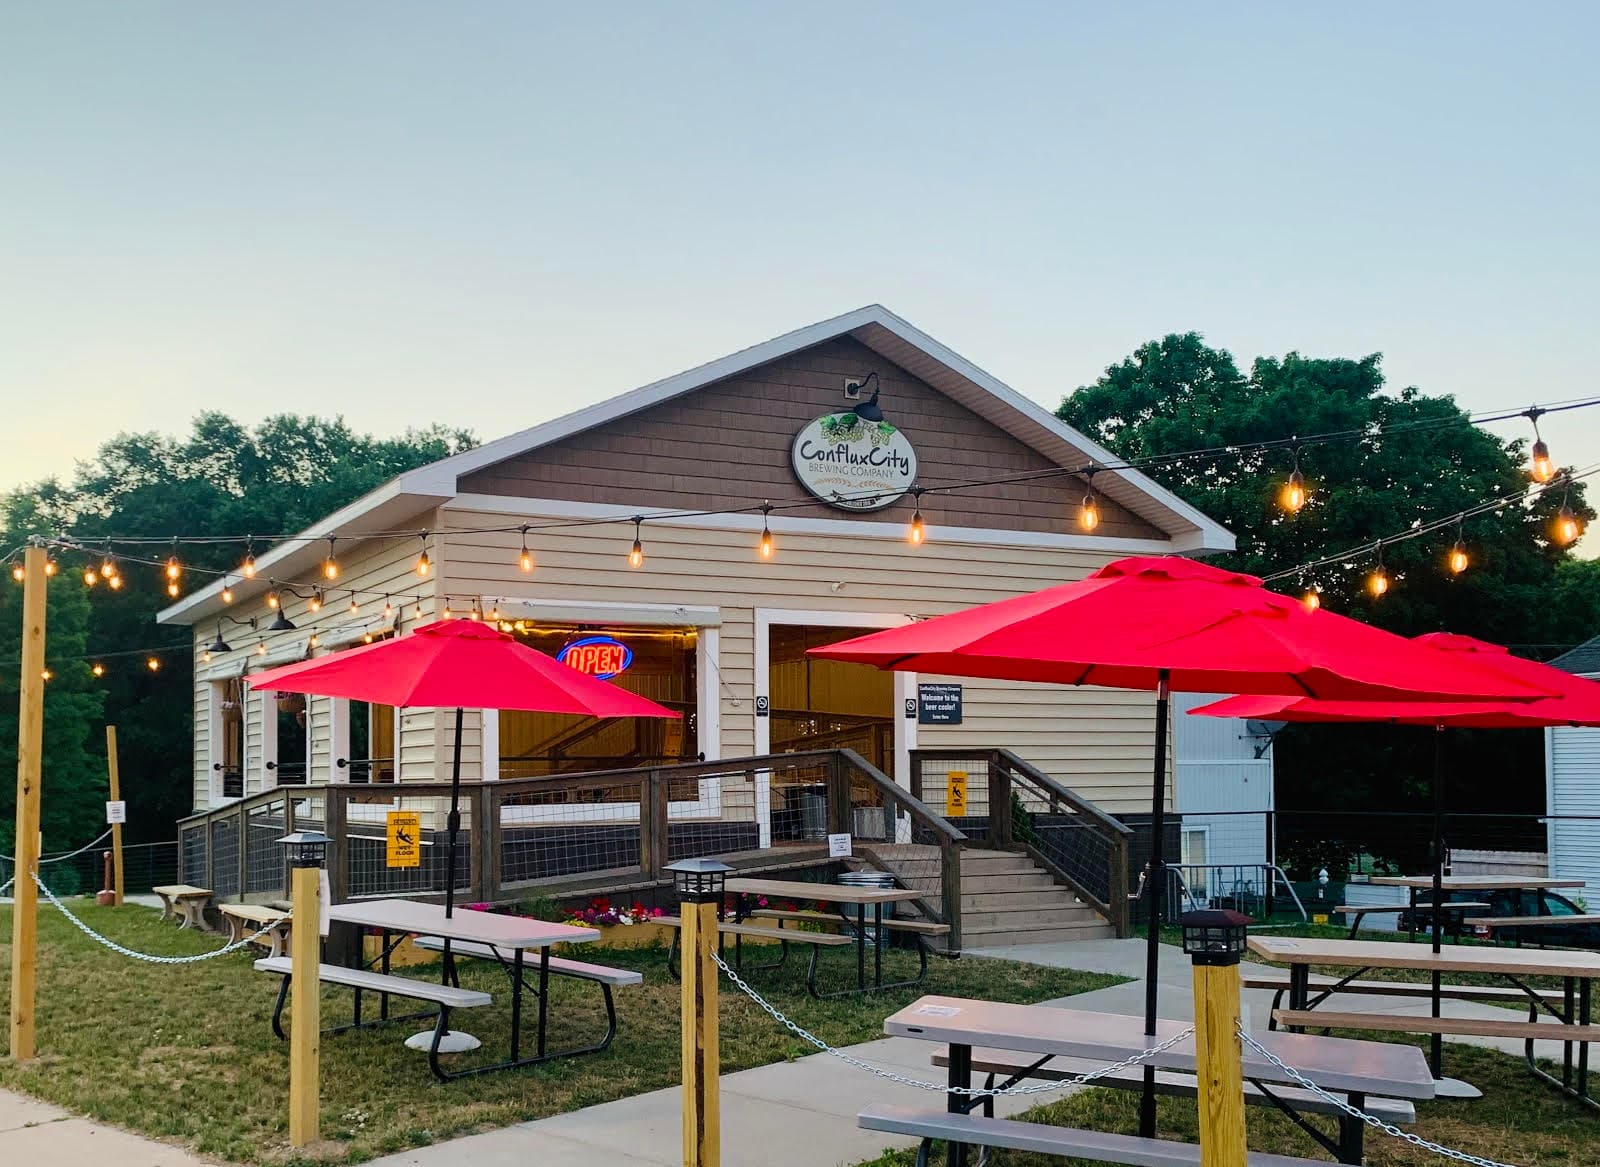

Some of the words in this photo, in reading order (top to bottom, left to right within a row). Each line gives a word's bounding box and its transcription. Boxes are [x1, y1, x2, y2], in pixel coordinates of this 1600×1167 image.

[800, 440, 909, 476] ConfluxCity
[808, 462, 849, 476] BREWING
[850, 466, 895, 478] COMPANY
[566, 646, 624, 674] OPEN
[921, 693, 944, 701] Welcome
[925, 702, 937, 710] beer
